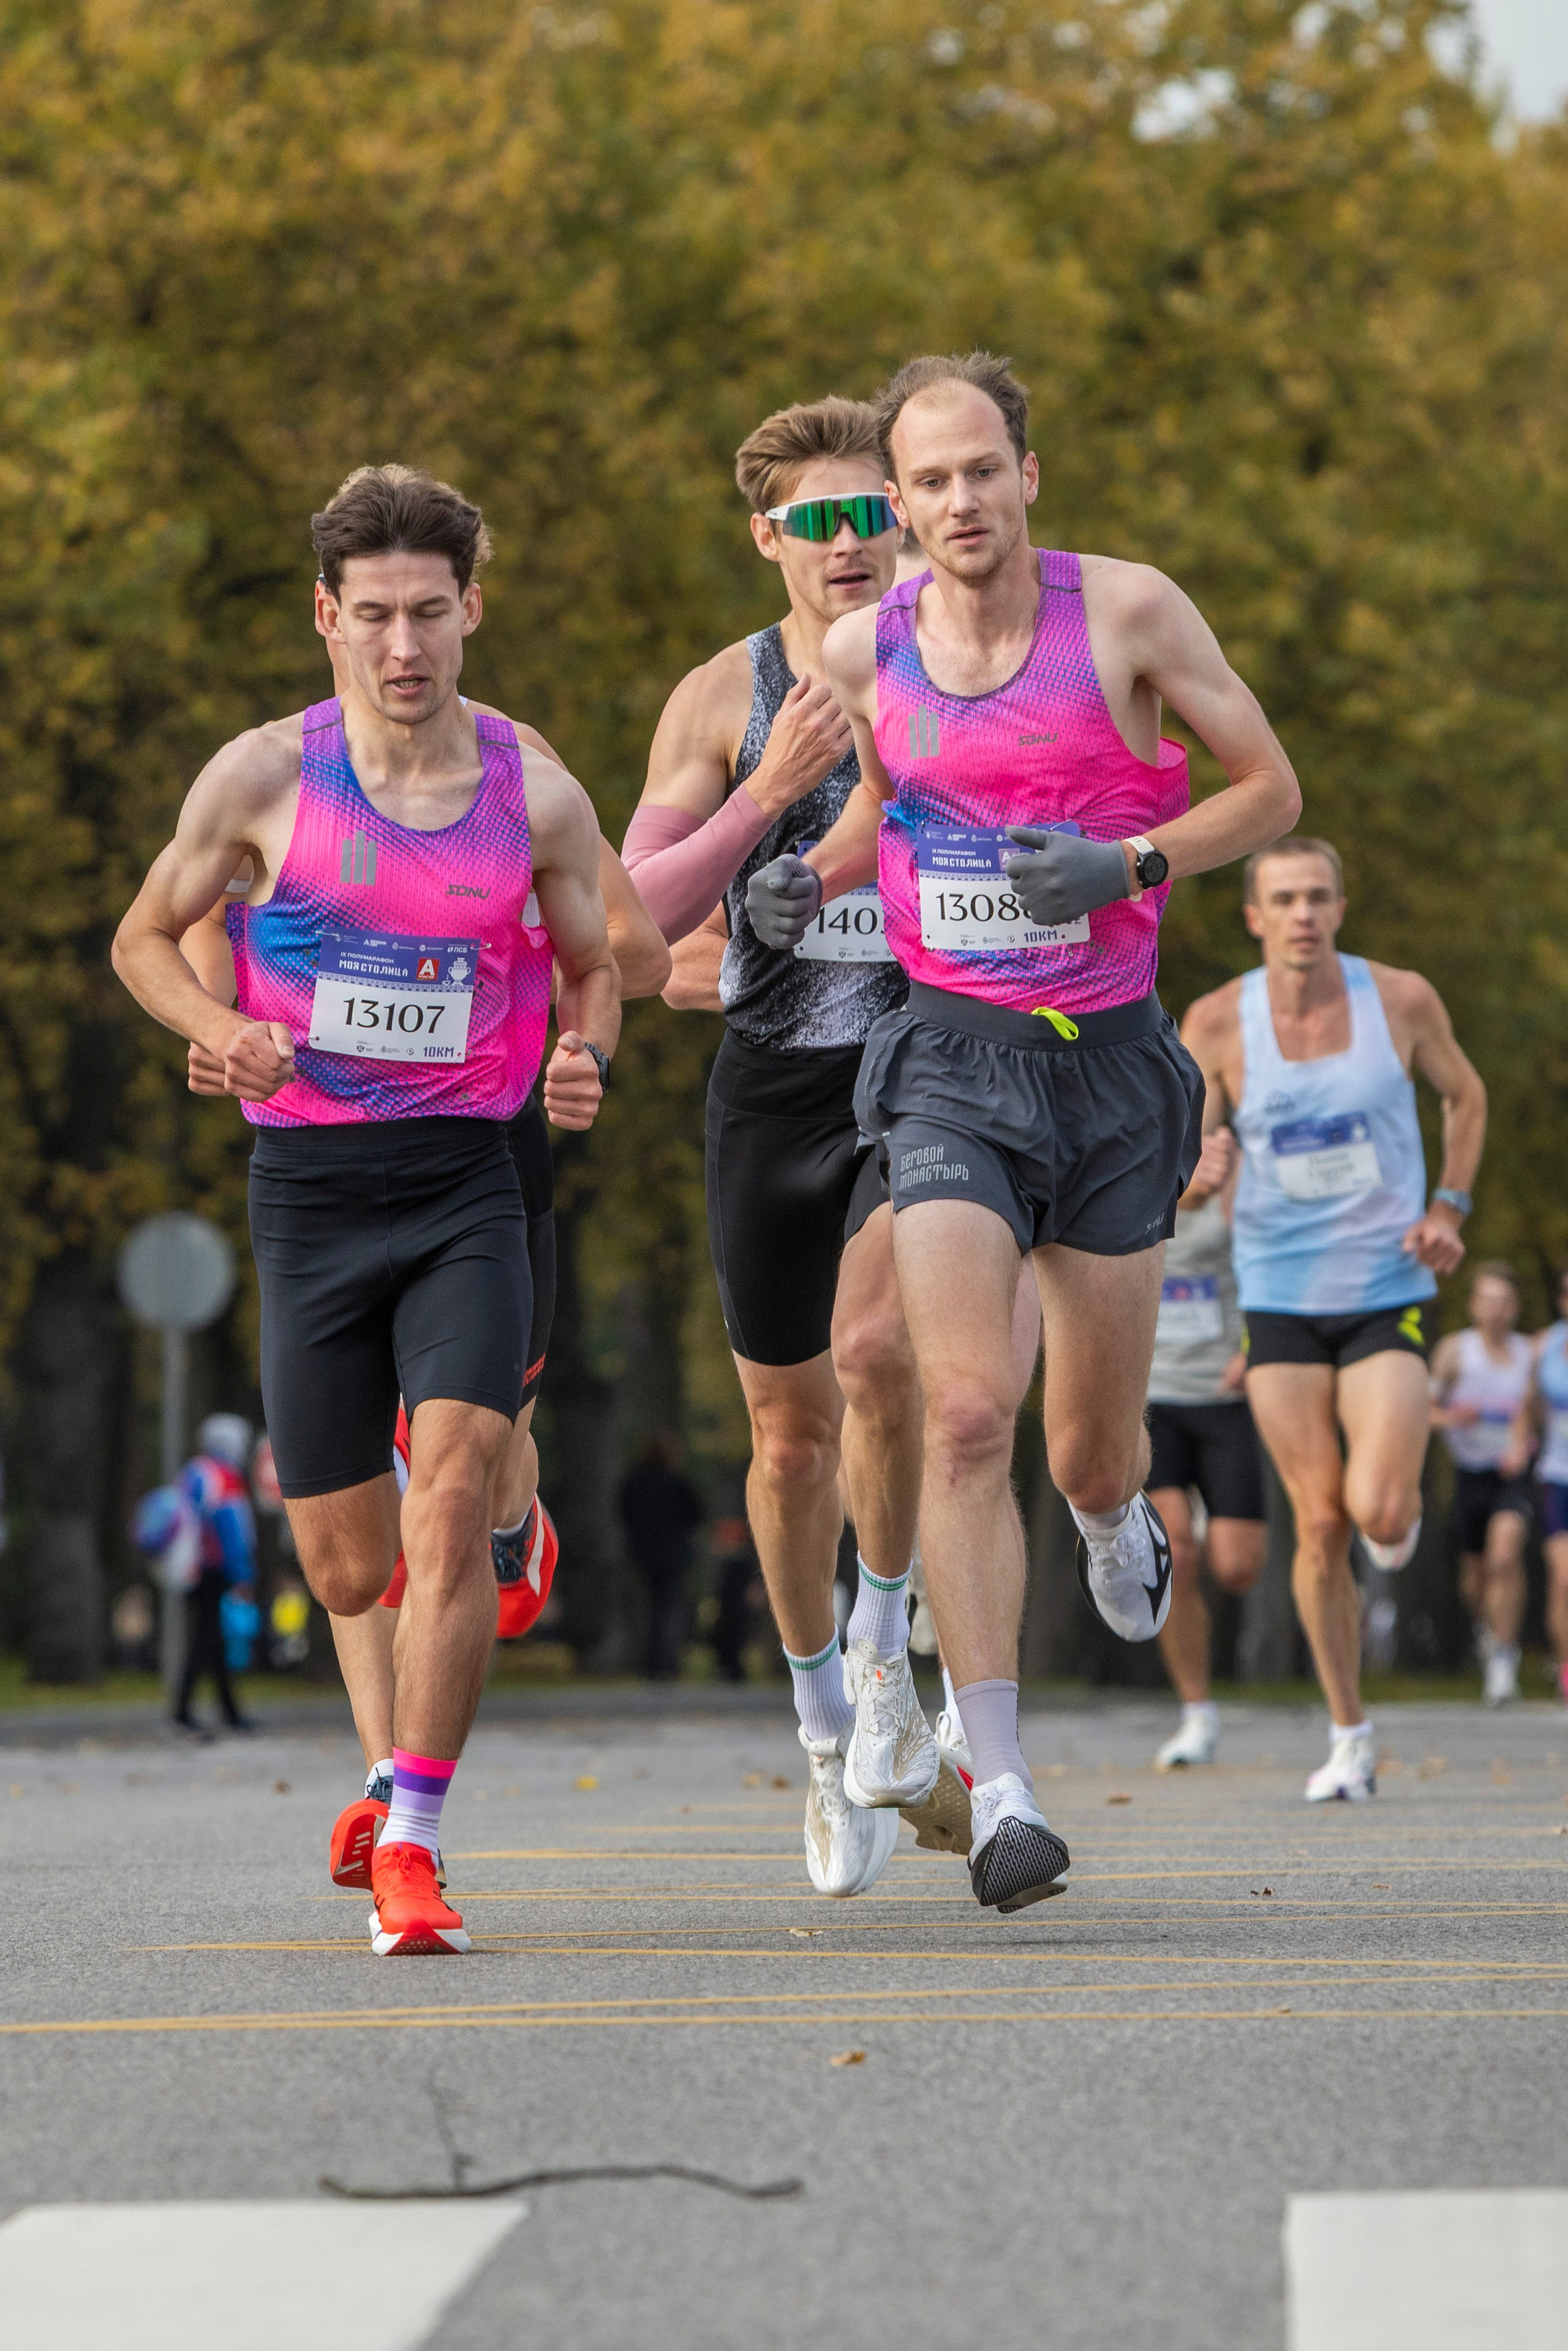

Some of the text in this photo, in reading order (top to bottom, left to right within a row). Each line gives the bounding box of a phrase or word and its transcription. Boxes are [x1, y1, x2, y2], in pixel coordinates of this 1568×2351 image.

[932, 856, 992, 868] МОЯ СТОЛИЦА
[936, 892, 1033, 922] 1308
[818, 907, 885, 935] 140
[339, 959, 408, 977] МОЯ СТОЛИЦА
[347, 952, 394, 964] ПОЛУМАРАФОН
[343, 997, 445, 1033] 13107
[899, 1163, 969, 1190] МОНАСТЫРЬ
